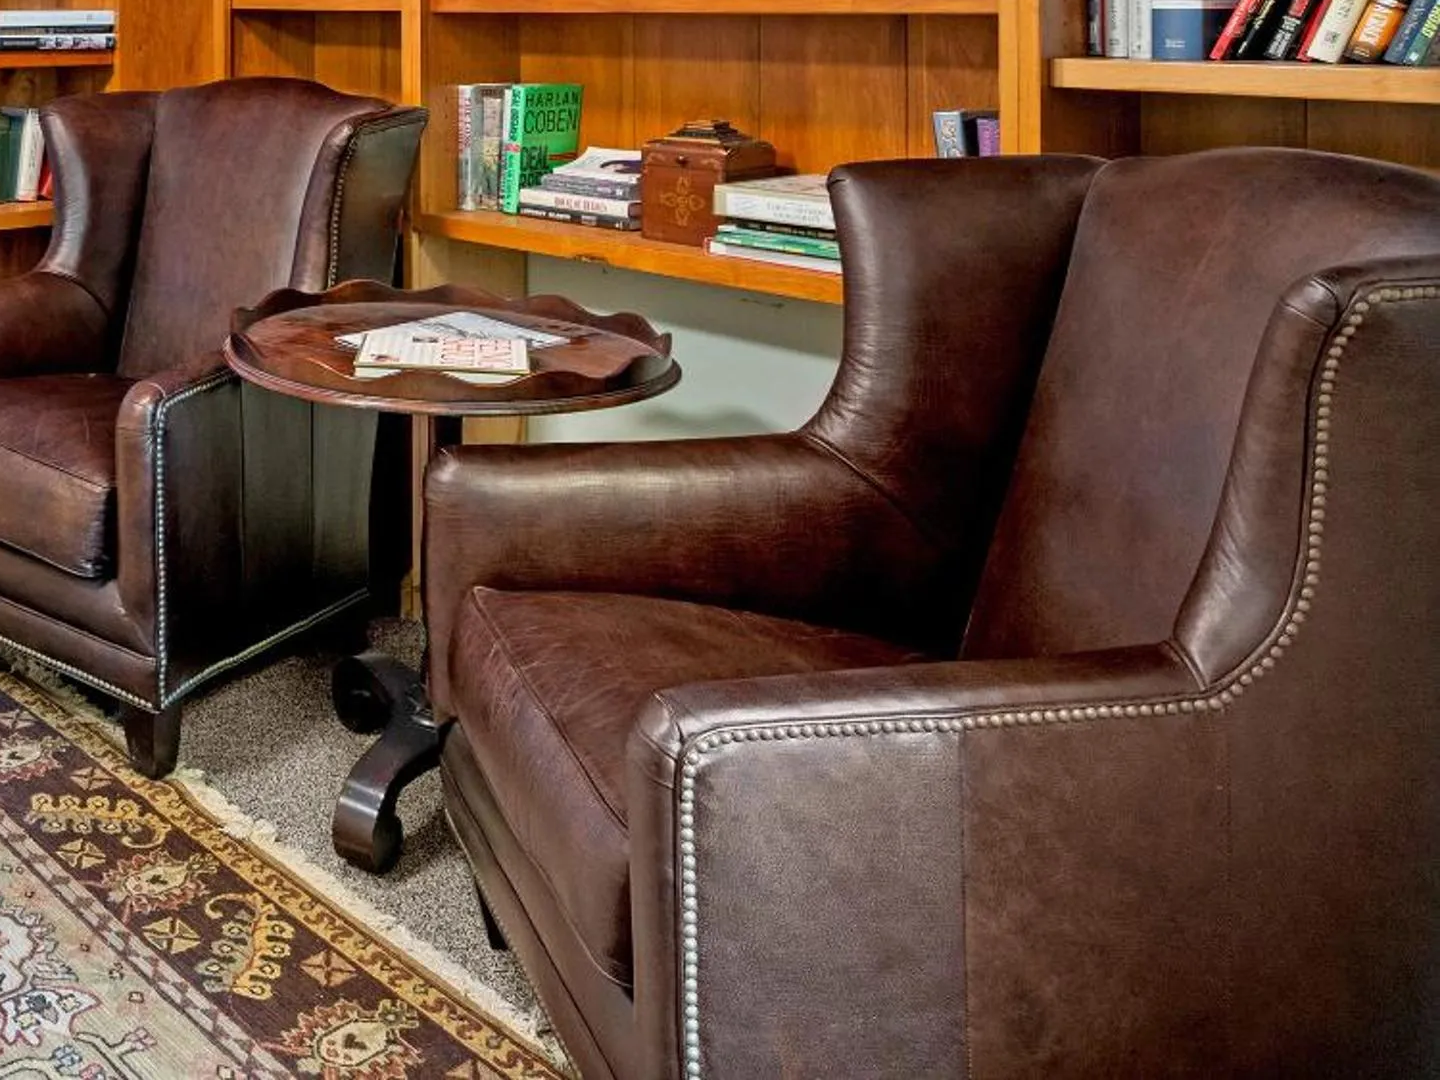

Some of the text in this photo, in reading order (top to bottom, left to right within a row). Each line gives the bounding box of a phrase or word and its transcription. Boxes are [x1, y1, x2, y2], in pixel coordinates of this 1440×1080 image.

[525, 91, 579, 107] HARLAN
[523, 108, 578, 134] COBEN
[519, 145, 549, 172] DEAL
